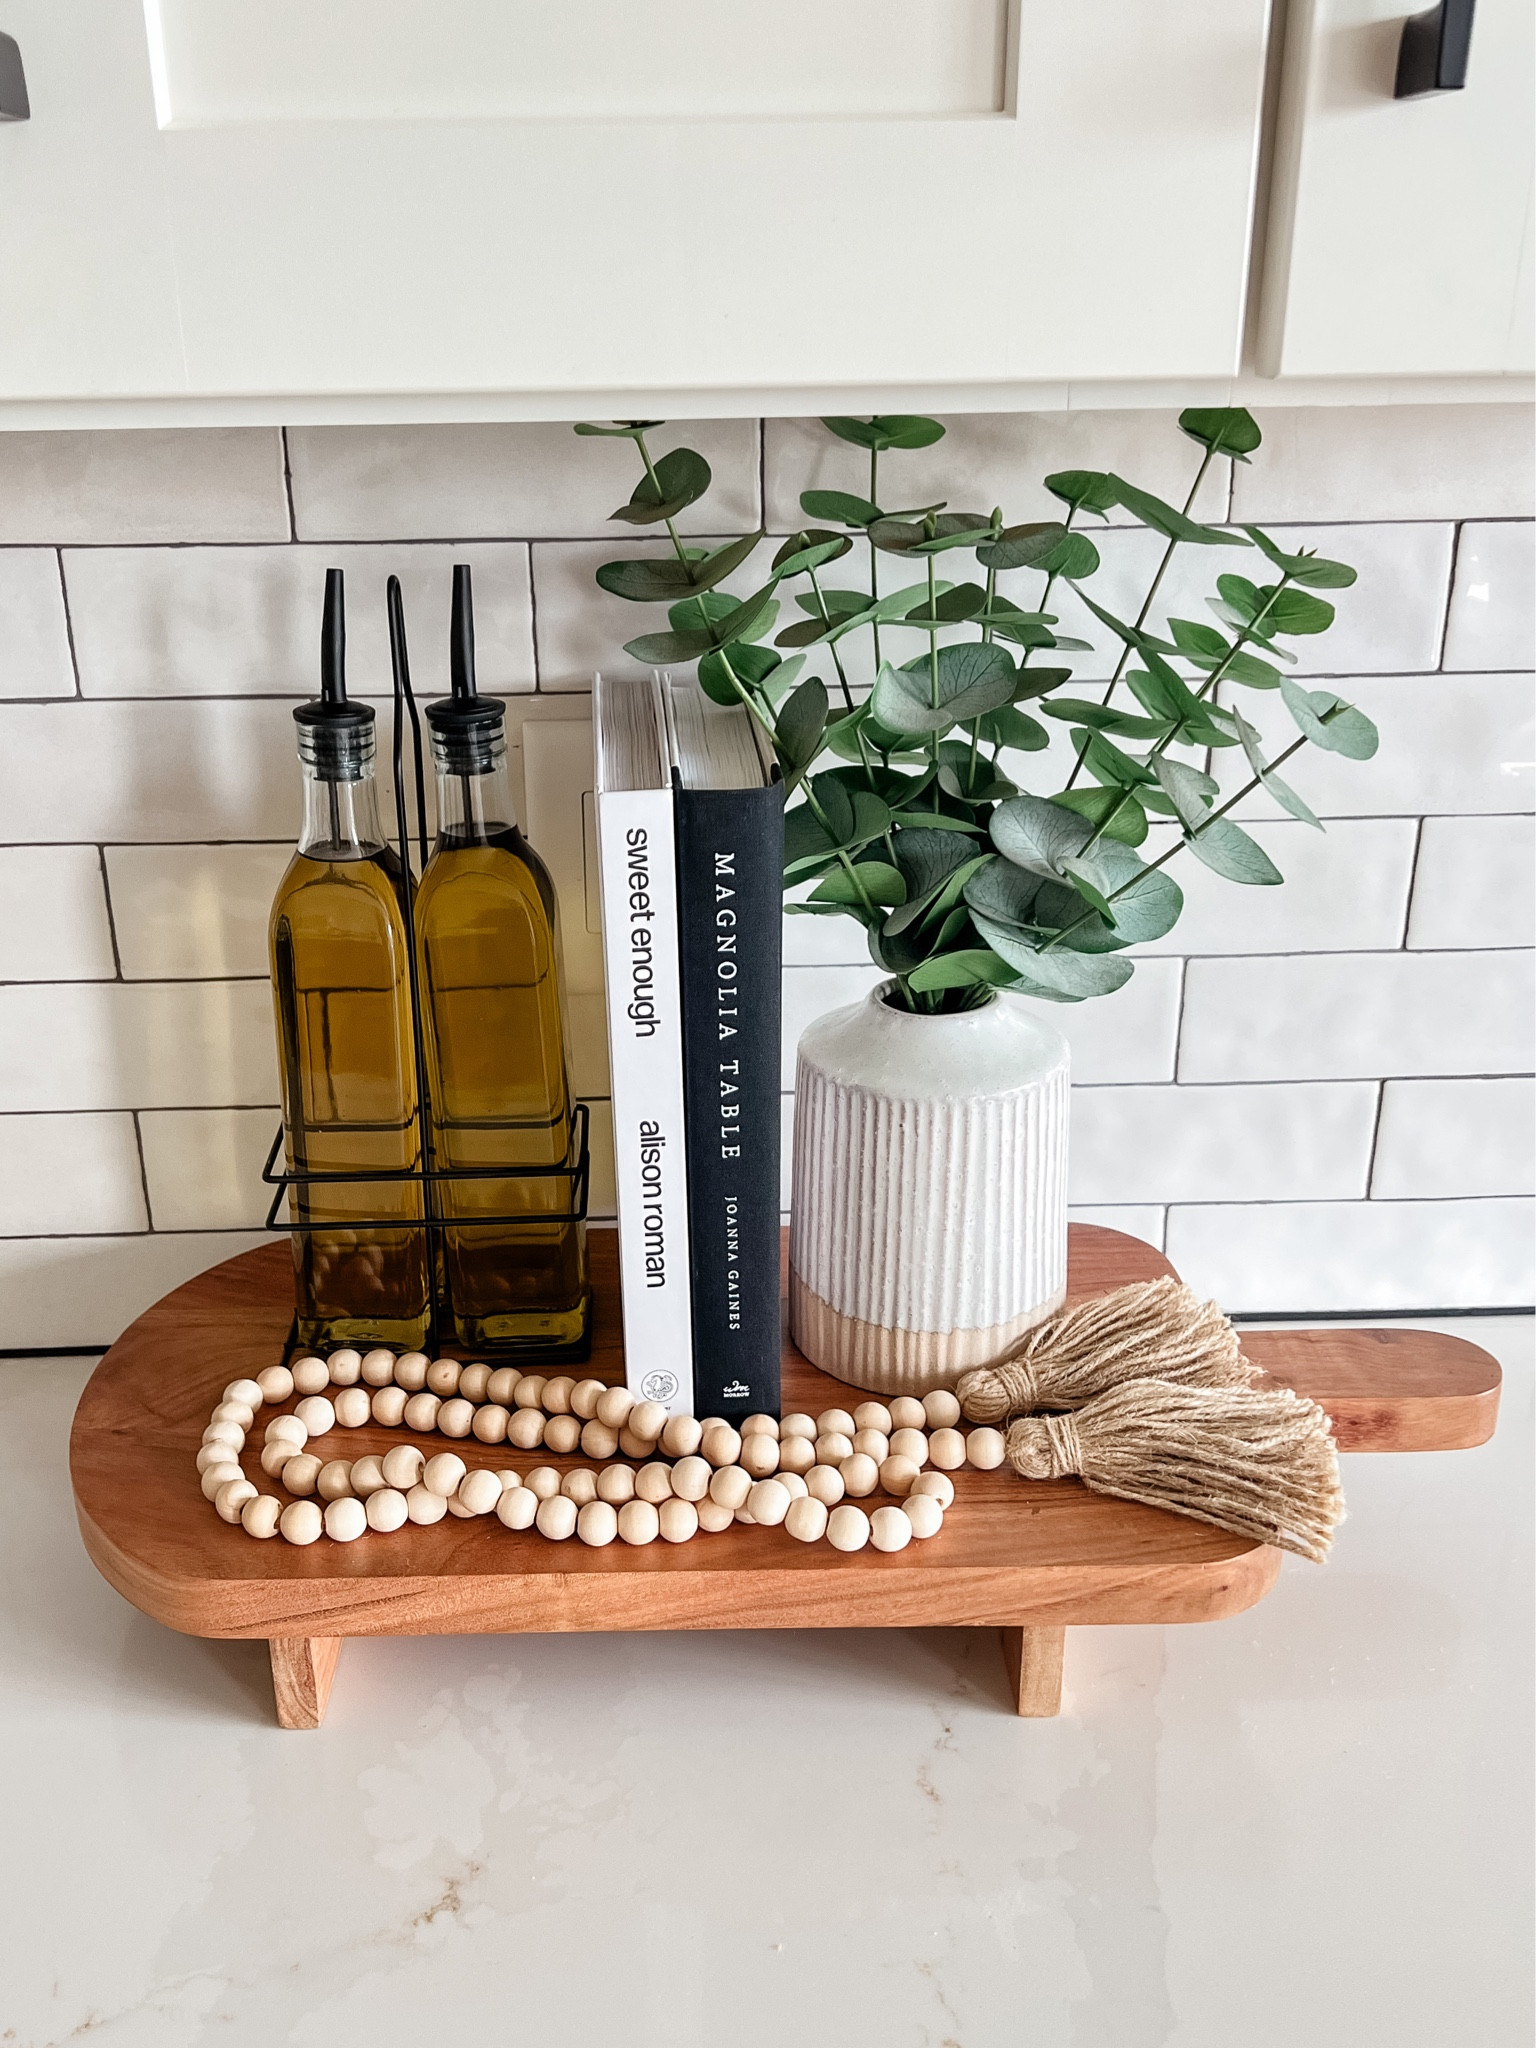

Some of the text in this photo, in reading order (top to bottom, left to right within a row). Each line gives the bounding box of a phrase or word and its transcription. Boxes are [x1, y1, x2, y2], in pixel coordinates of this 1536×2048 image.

[626, 828, 661, 1038] sweet enough
[714, 852, 740, 1159] MAGNOLIA TABLE
[639, 1120, 666, 1288] alison roman
[724, 1196, 741, 1330] JOANNA GAINES
